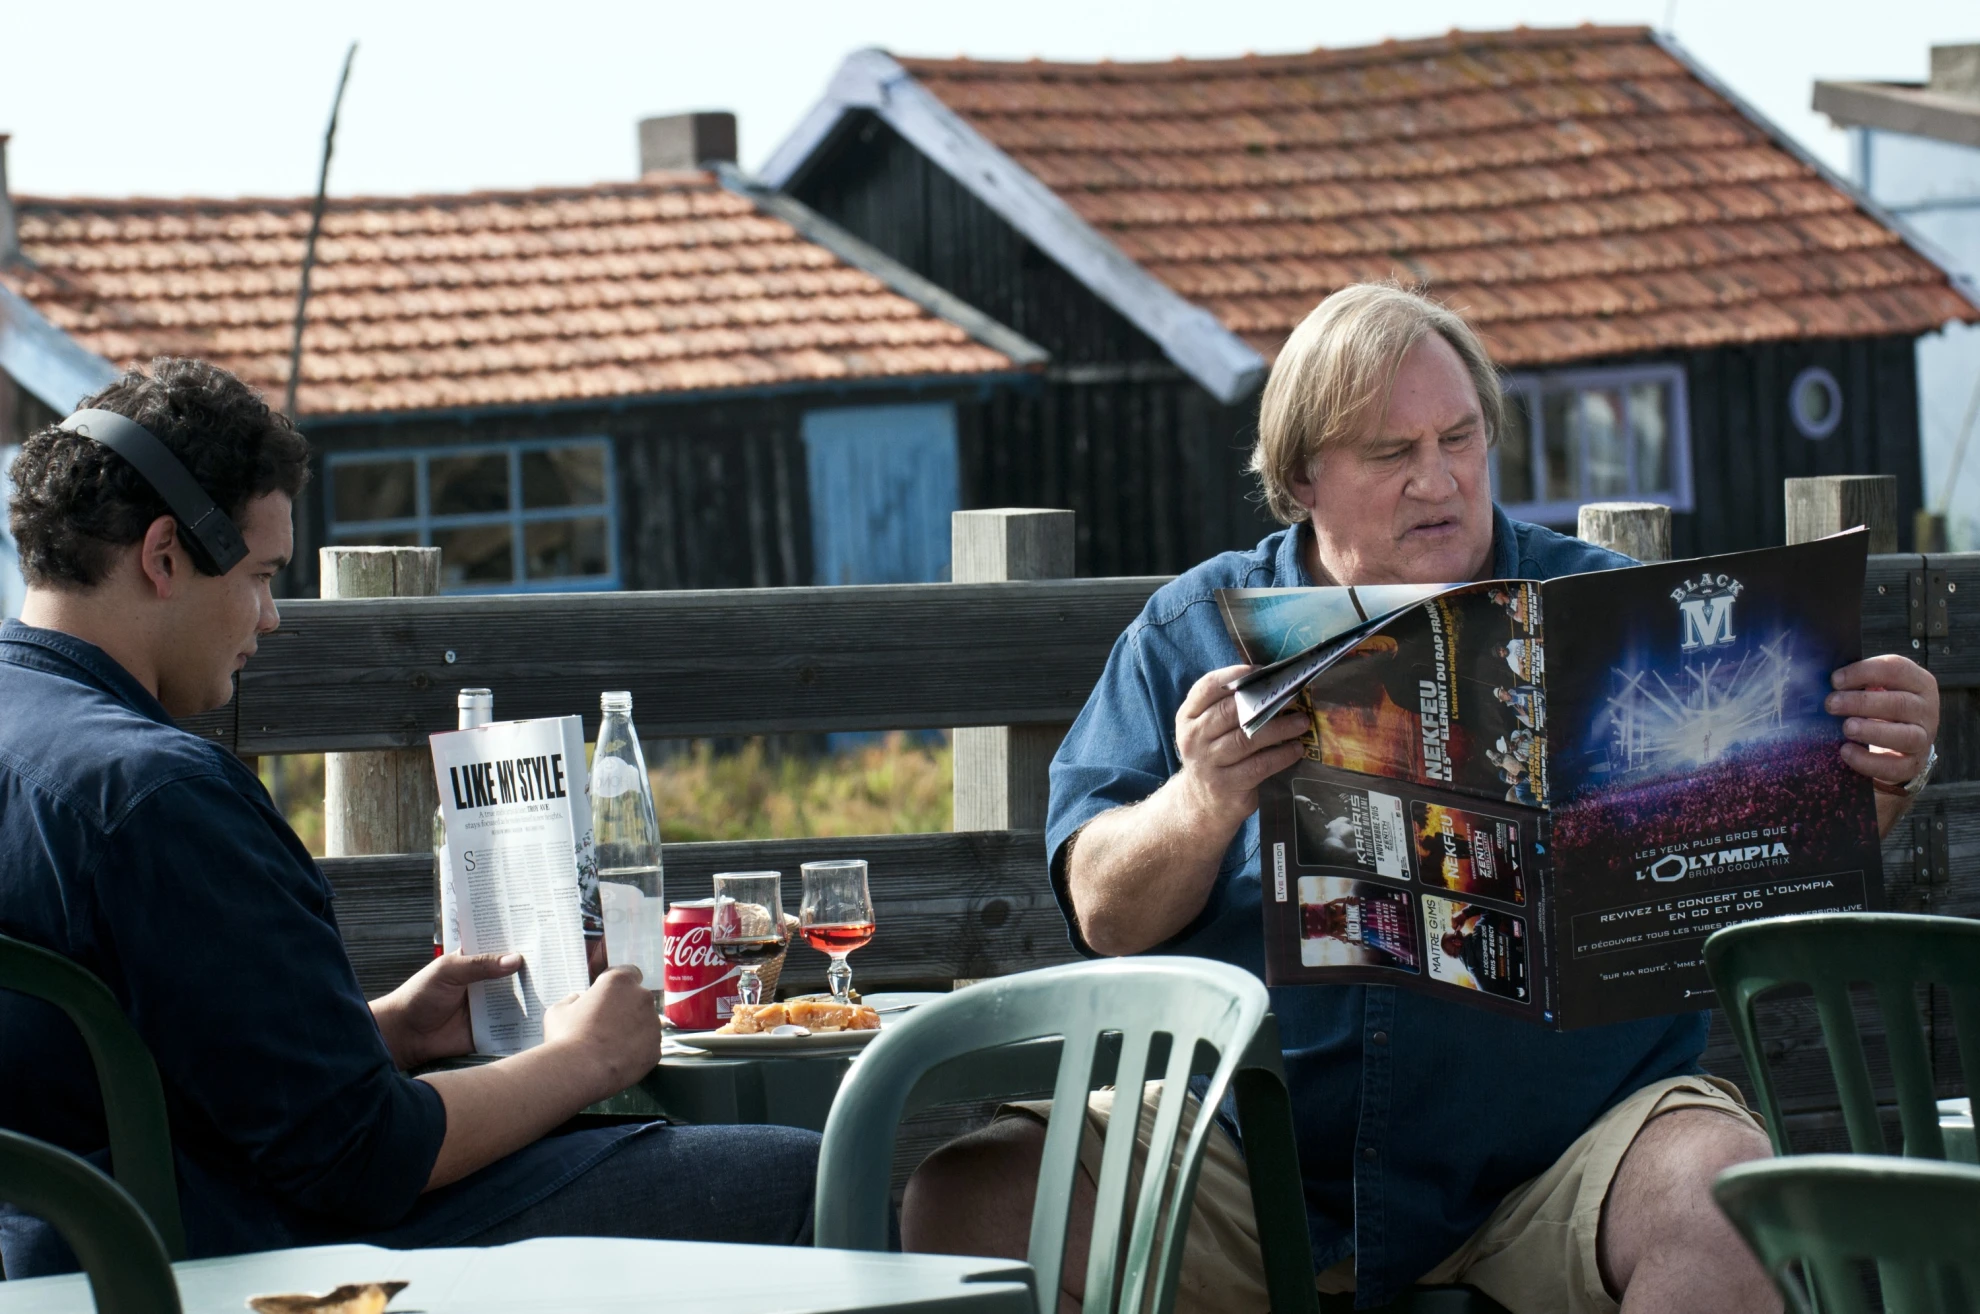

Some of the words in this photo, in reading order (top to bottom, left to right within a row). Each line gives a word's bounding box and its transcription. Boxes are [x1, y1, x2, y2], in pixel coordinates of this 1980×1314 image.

[1670, 573, 1744, 603] BLACK
[1520, 583, 1529, 632] SOPRANO
[1679, 595, 1737, 650] M
[1445, 625, 1453, 635] de
[1303, 641, 1346, 675] NICKI
[1433, 635, 1445, 661] RAP
[1436, 662, 1447, 681] DU
[1253, 673, 1300, 712] MINAJ
[1450, 672, 1459, 719] L'interview
[1438, 682, 1450, 740] ELEMENT
[1419, 679, 1443, 780] NEKFEU
[1529, 744, 1534, 754] M
[450, 762, 497, 810] LIKE
[496, 759, 518, 805] MY
[516, 753, 567, 803] STYLE
[1443, 767, 1453, 782] LE
[1528, 758, 1536, 794] BLACK
[1360, 796, 1368, 811] AME
[1371, 805, 1380, 821] 2015
[465, 821, 481, 830] stays
[1350, 794, 1367, 865] KAARIS
[1362, 812, 1370, 827] MON
[1363, 828, 1372, 837] DE
[1364, 838, 1374, 857] BRUIT
[1372, 822, 1384, 857] NOVEMBRE
[1382, 820, 1390, 851] ZENITH
[1440, 814, 1460, 879] NEKFEU
[1635, 848, 1656, 860] LES
[1660, 842, 1689, 854] YEUX
[1692, 836, 1721, 848] PLUS
[1726, 830, 1758, 842] GROS
[1763, 826, 1788, 838] QUE
[1367, 859, 1375, 867] LE
[1474, 830, 1488, 878] ZENITH
[1636, 842, 1790, 882] L'OLYMPIA
[1688, 866, 1724, 879] BRUNO
[1727, 856, 1790, 872] COQUATRIX
[1346, 906, 1360, 922] INK
[1374, 901, 1382, 916] 2015
[1382, 902, 1390, 923] PARIS
[1426, 899, 1438, 930] GIMS
[1600, 906, 1653, 923] REVIVEZ
[1658, 903, 1673, 912] LE
[1677, 892, 1738, 909] CONCERT
[1744, 889, 1762, 900] DE
[1766, 880, 1835, 896] L'OLYMPIA
[1669, 910, 1686, 922] EN
[1691, 907, 1710, 918] CD
[1714, 904, 1731, 914] ET
[1736, 900, 1764, 912] DVD
[1347, 922, 1361, 940] KID
[1377, 916, 1385, 940] OCTOBRE
[1390, 904, 1399, 939] VILLETTE
[1578, 944, 1588, 952] ET
[1591, 935, 1643, 950] DÉCOUVREZ
[1646, 930, 1670, 940] TOUS
[1673, 927, 1690, 936] LES
[1693, 922, 1722, 932] TUBES
[1843, 904, 1862, 912] LIVE
[1394, 942, 1401, 951] LA
[1430, 932, 1441, 974] MAITRE
